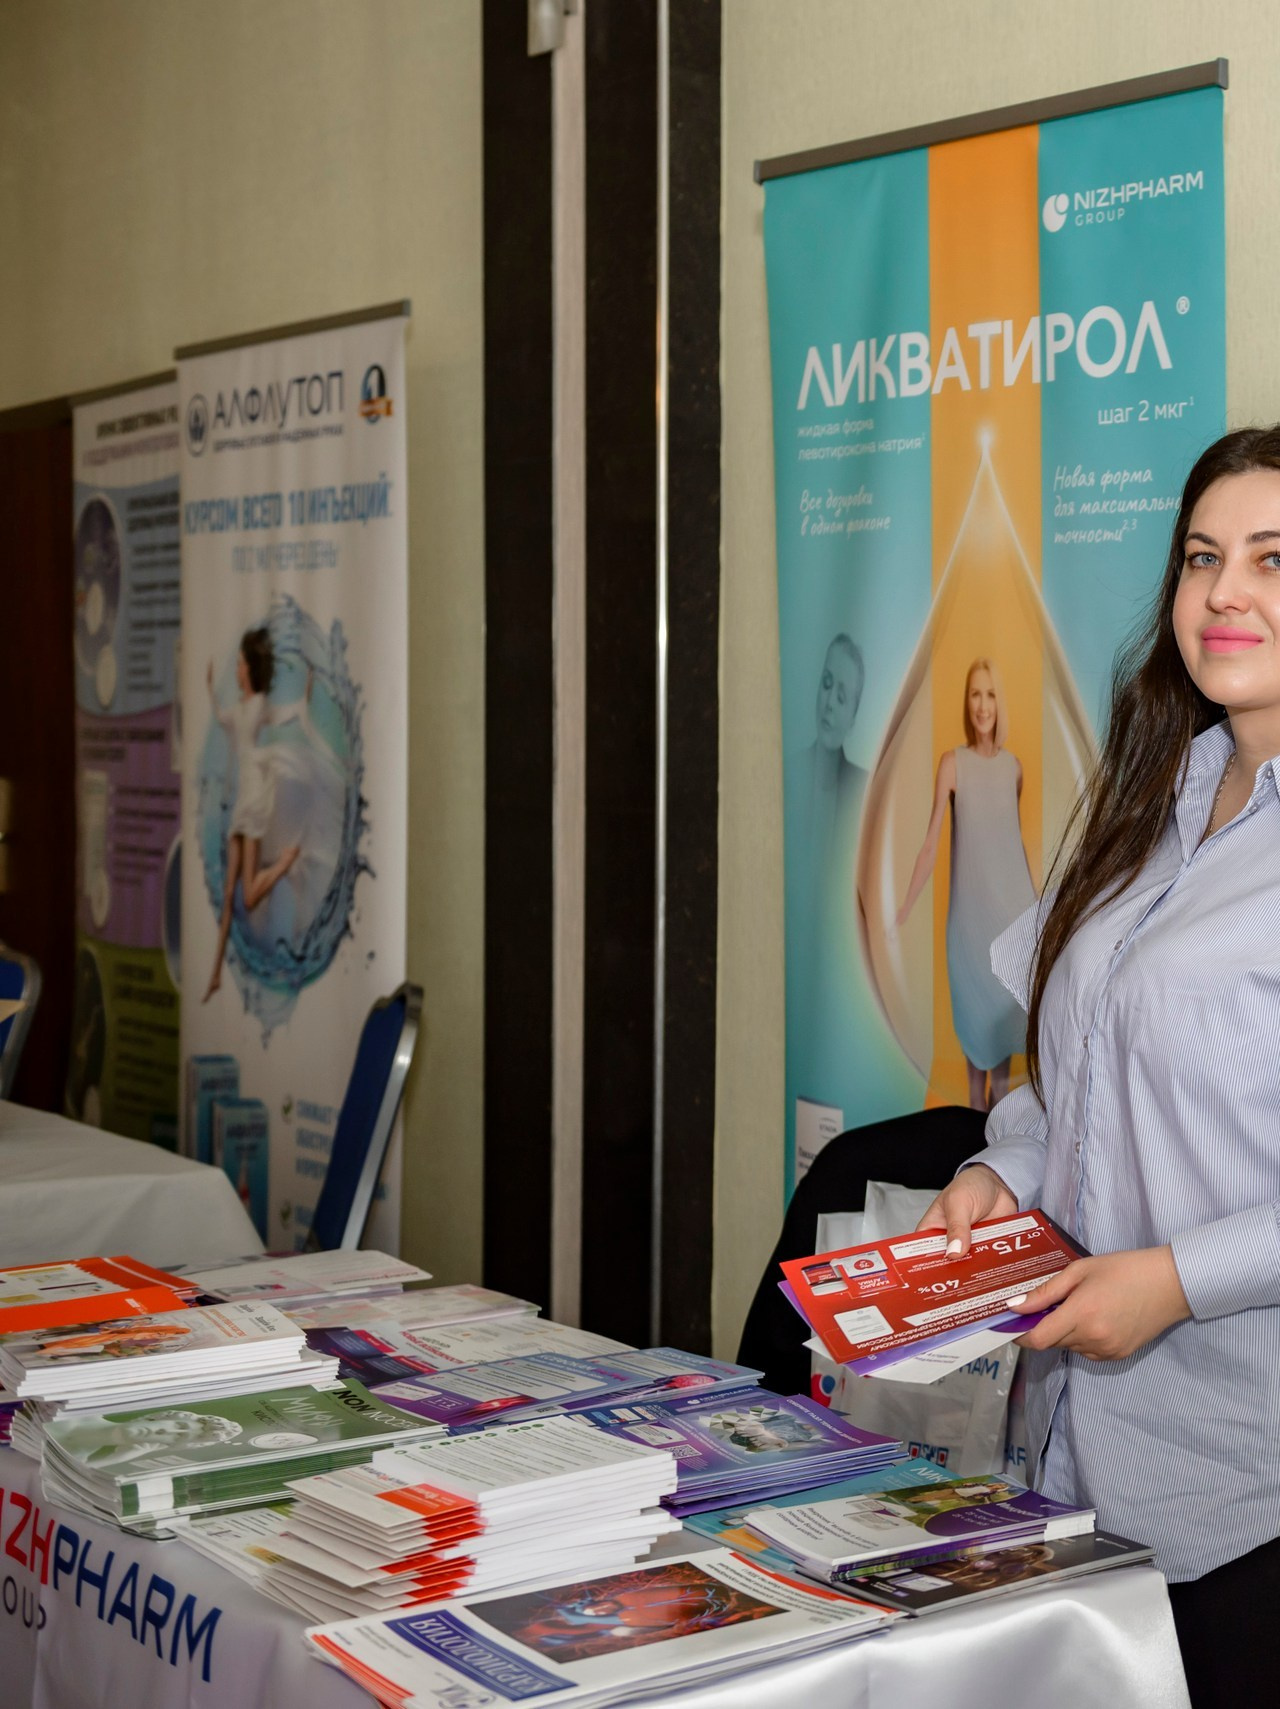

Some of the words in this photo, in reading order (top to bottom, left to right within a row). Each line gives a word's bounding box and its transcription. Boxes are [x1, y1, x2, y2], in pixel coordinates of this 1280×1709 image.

[1074, 171, 1204, 211] NIZHPHARM
[1075, 208, 1126, 227] GROUP
[212, 370, 346, 430] АЛФЛУТОП
[1098, 404, 1133, 425] шаг
[1138, 400, 1150, 422] 2
[843, 417, 874, 437] форма
[1054, 464, 1096, 492] Новая
[1100, 468, 1153, 493] форма
[1054, 495, 1075, 517] для
[992, 1236, 1031, 1255] 75
[333, 1390, 378, 1413] NON
[410, 1618, 551, 1695] КАРДИОЛОГИЯ
